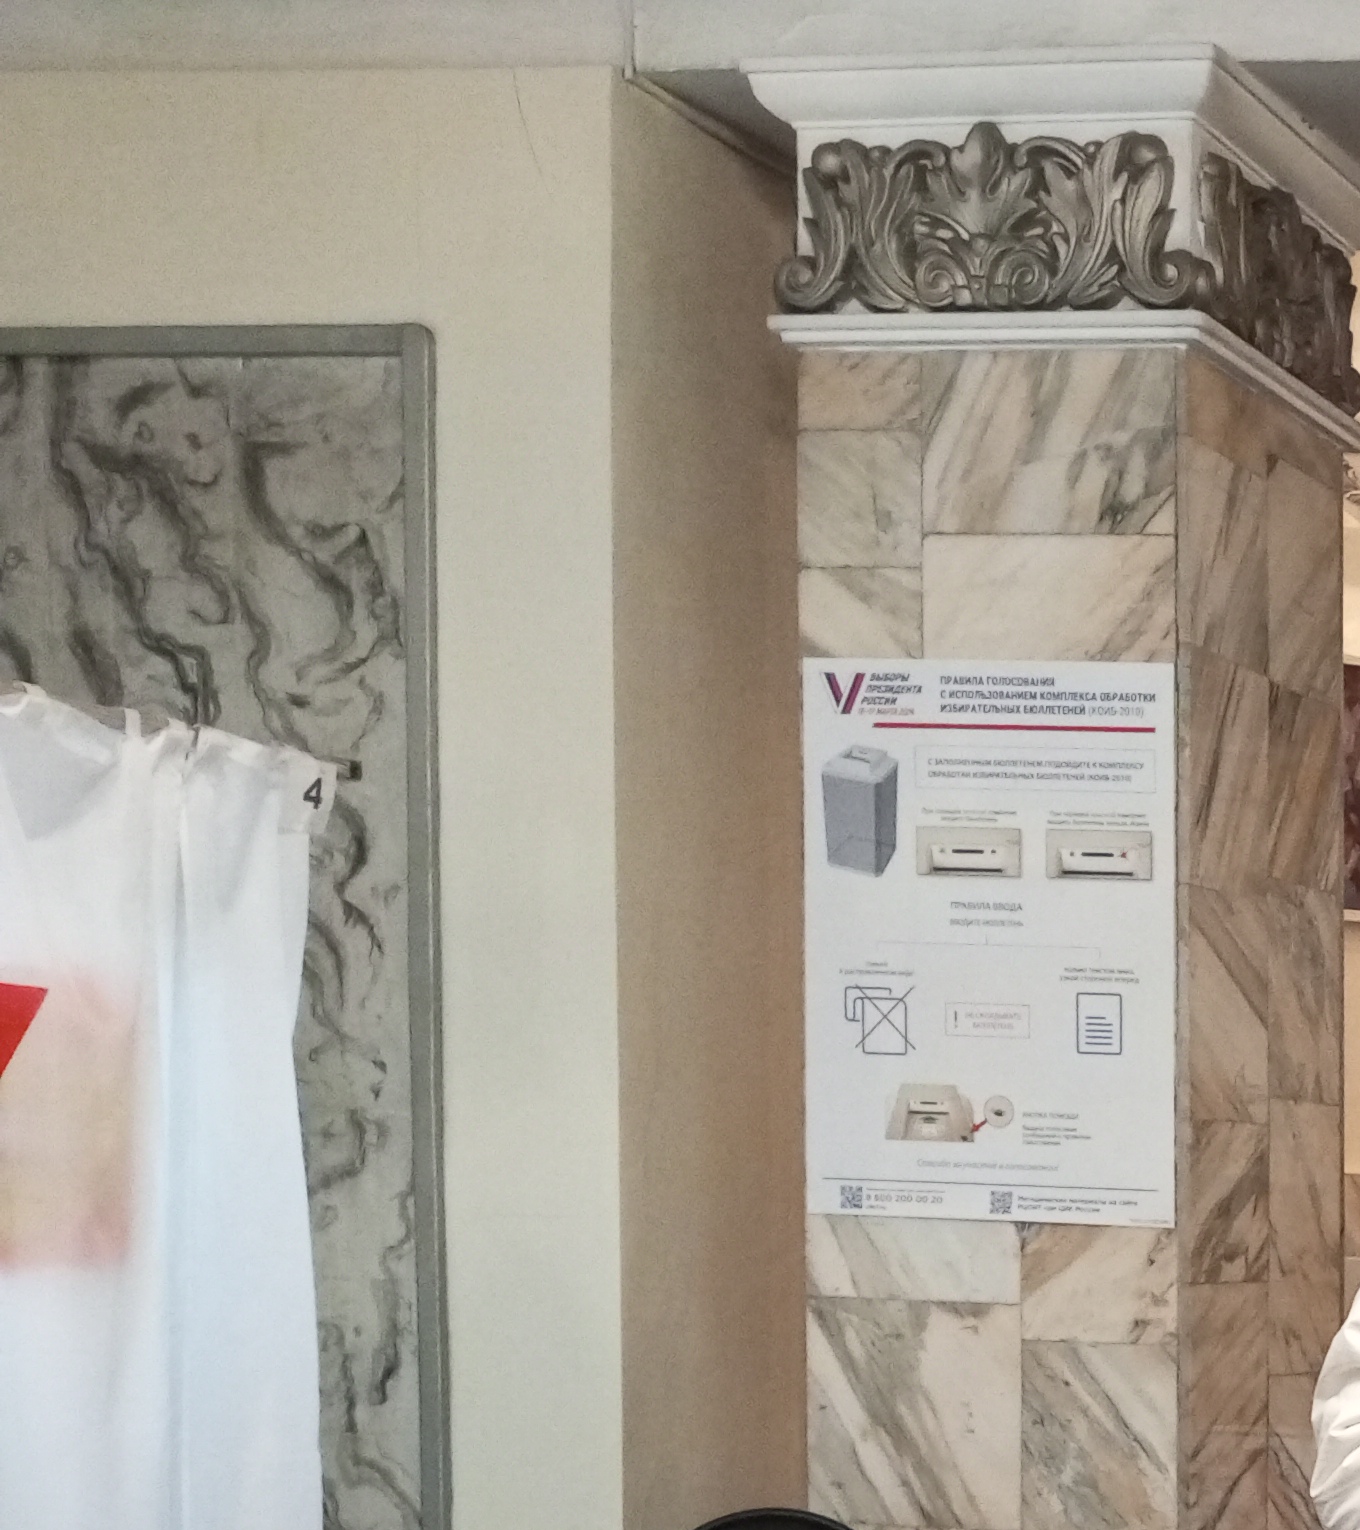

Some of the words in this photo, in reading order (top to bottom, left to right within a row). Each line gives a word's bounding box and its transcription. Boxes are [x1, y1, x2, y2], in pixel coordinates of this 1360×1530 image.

[869, 672, 911, 682] ВЫБОРЫ
[940, 675, 985, 686] ПРАВИЛА
[986, 676, 1055, 687] ГОЛОСОВАНИЯ
[864, 684, 922, 694] ПРЕЗИДЕНТА
[861, 696, 897, 705] РОССИИ
[940, 690, 947, 699] С
[948, 690, 1038, 700] ИСПОЛЬЗОВАНИЕМ
[1039, 691, 1098, 701] КОМПЛЕКСА
[1100, 692, 1156, 703] ОБРАБОТКИ
[940, 703, 1021, 714] ИЗБИРАТЕЛЬНЫХ
[1023, 704, 1086, 715] БЮЛЛЕТЕНЕЙ
[303, 777, 323, 810] 4
